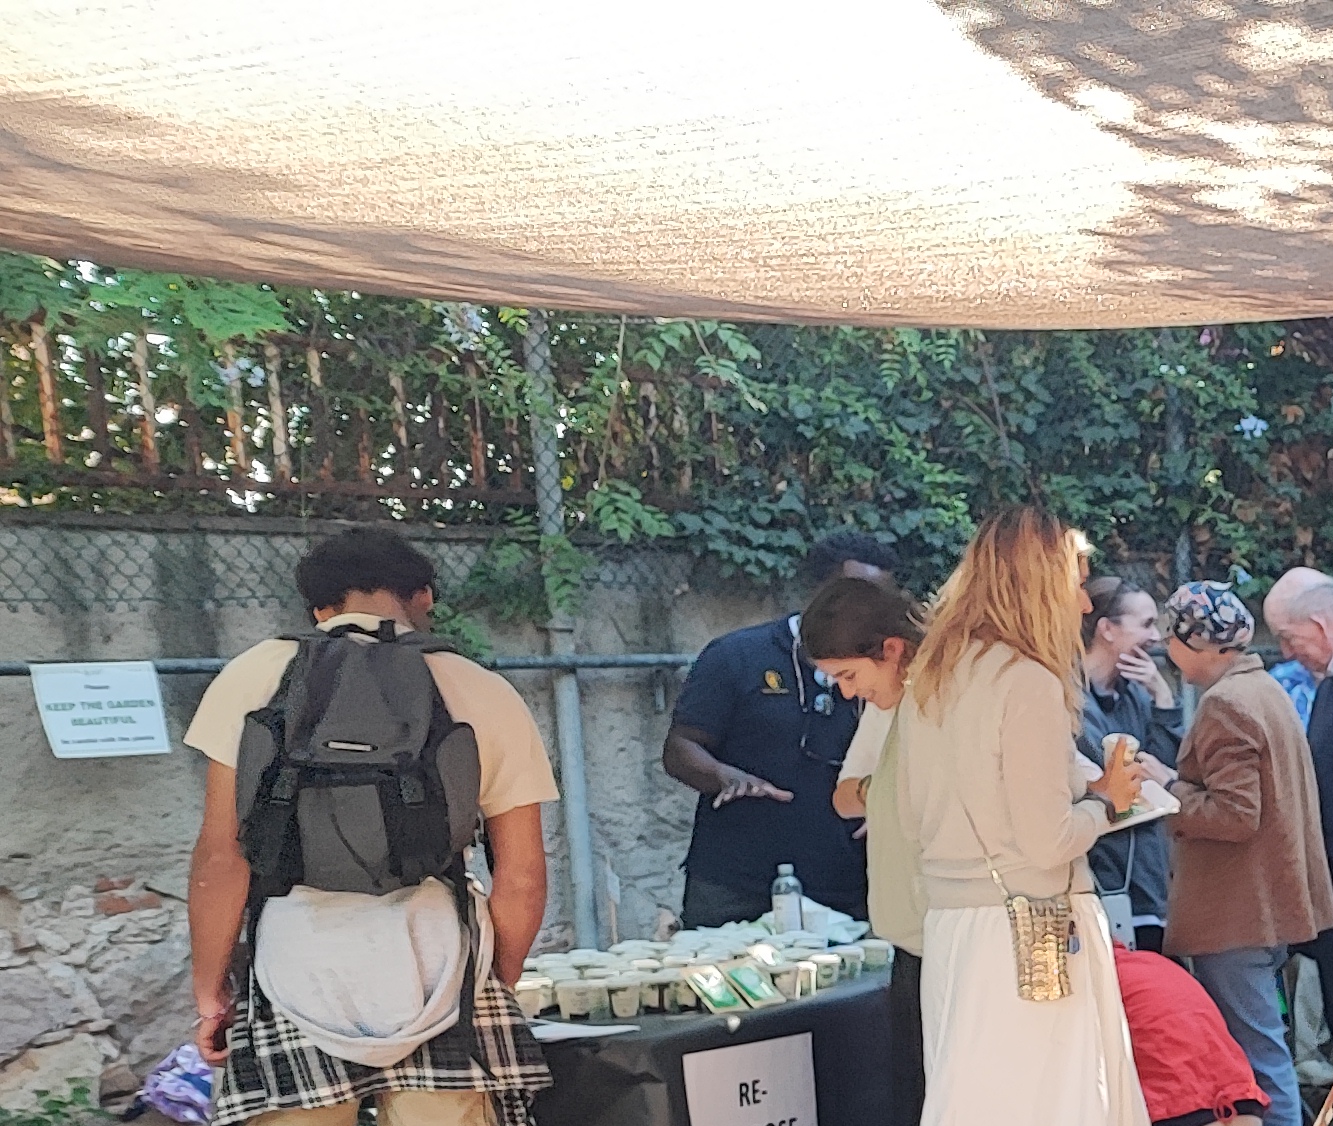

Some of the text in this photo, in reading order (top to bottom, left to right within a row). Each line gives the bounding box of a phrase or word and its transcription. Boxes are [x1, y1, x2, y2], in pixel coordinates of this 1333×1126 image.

[45, 699, 156, 711] KEEP THE GARDEN
[71, 716, 137, 726] BEAUTIFUL
[739, 1080, 768, 1107] RE-
